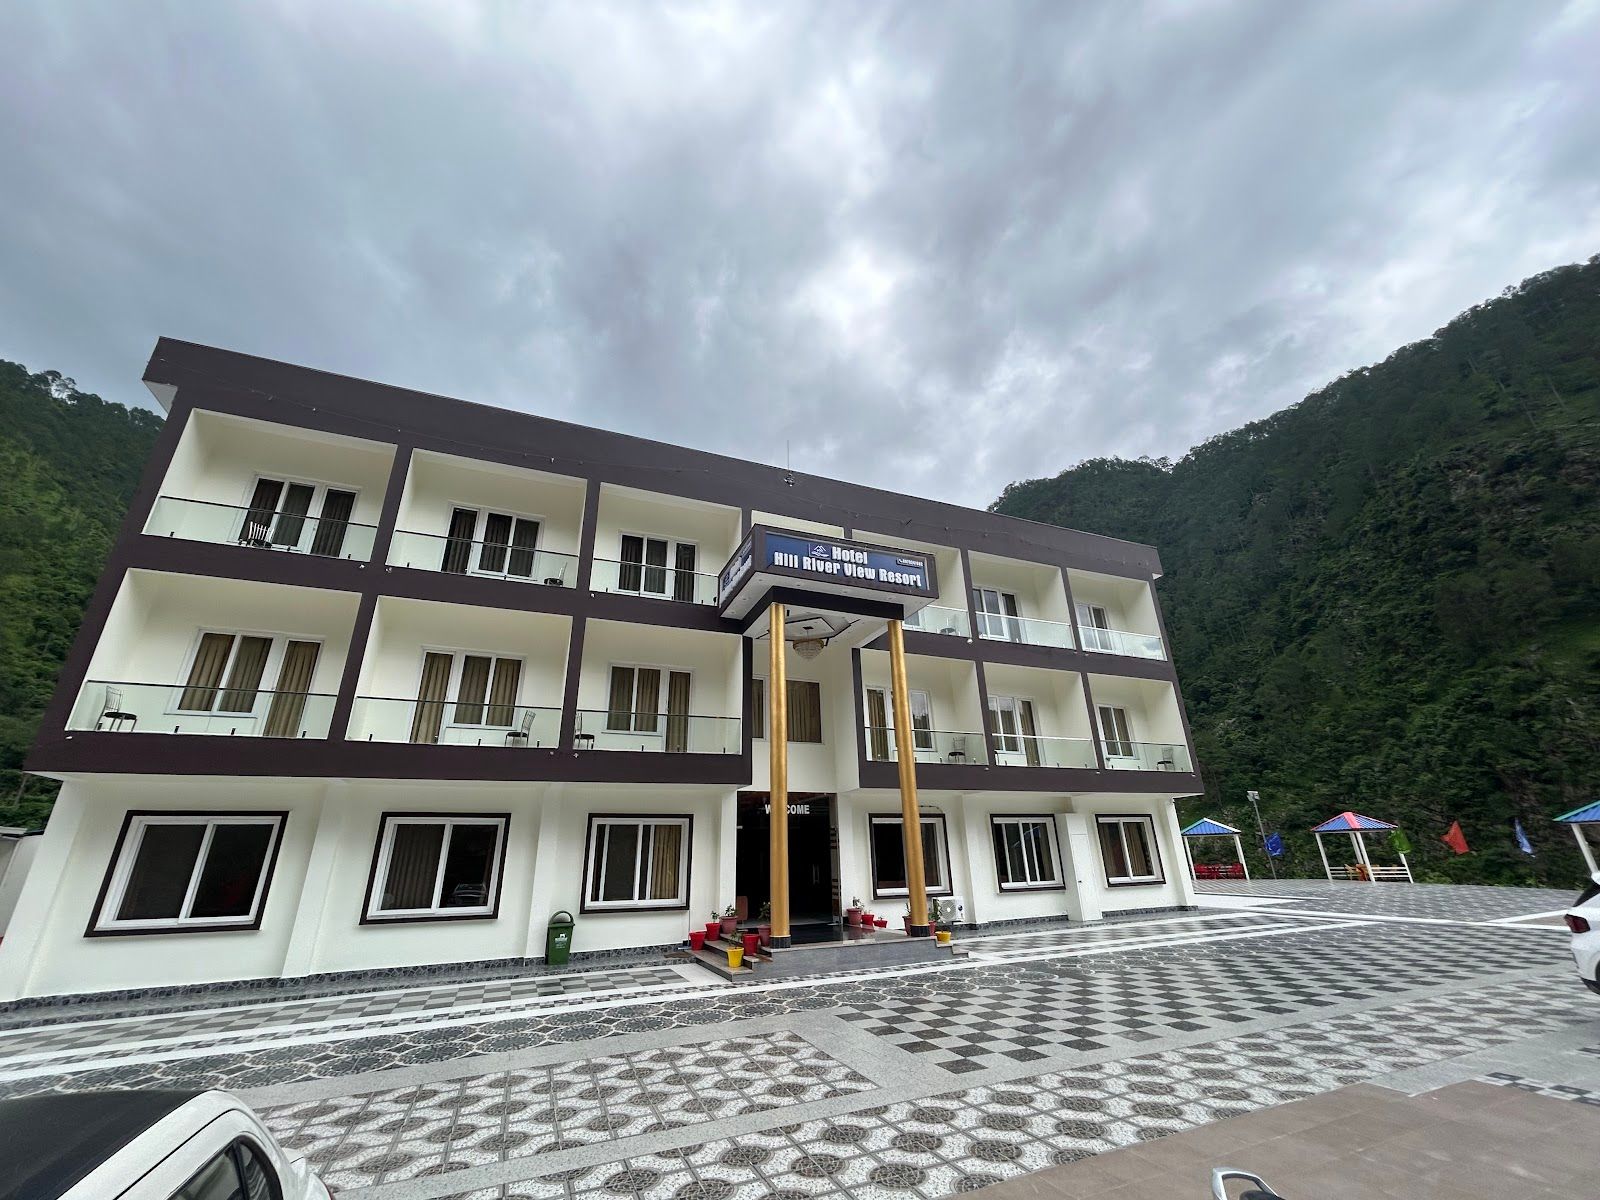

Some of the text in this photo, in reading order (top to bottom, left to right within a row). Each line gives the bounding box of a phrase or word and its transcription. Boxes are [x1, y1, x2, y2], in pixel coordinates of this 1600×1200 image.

[832, 546, 868, 564] Hotel
[774, 551, 922, 586] Hill River View Resort
[765, 804, 810, 814] WCOME
